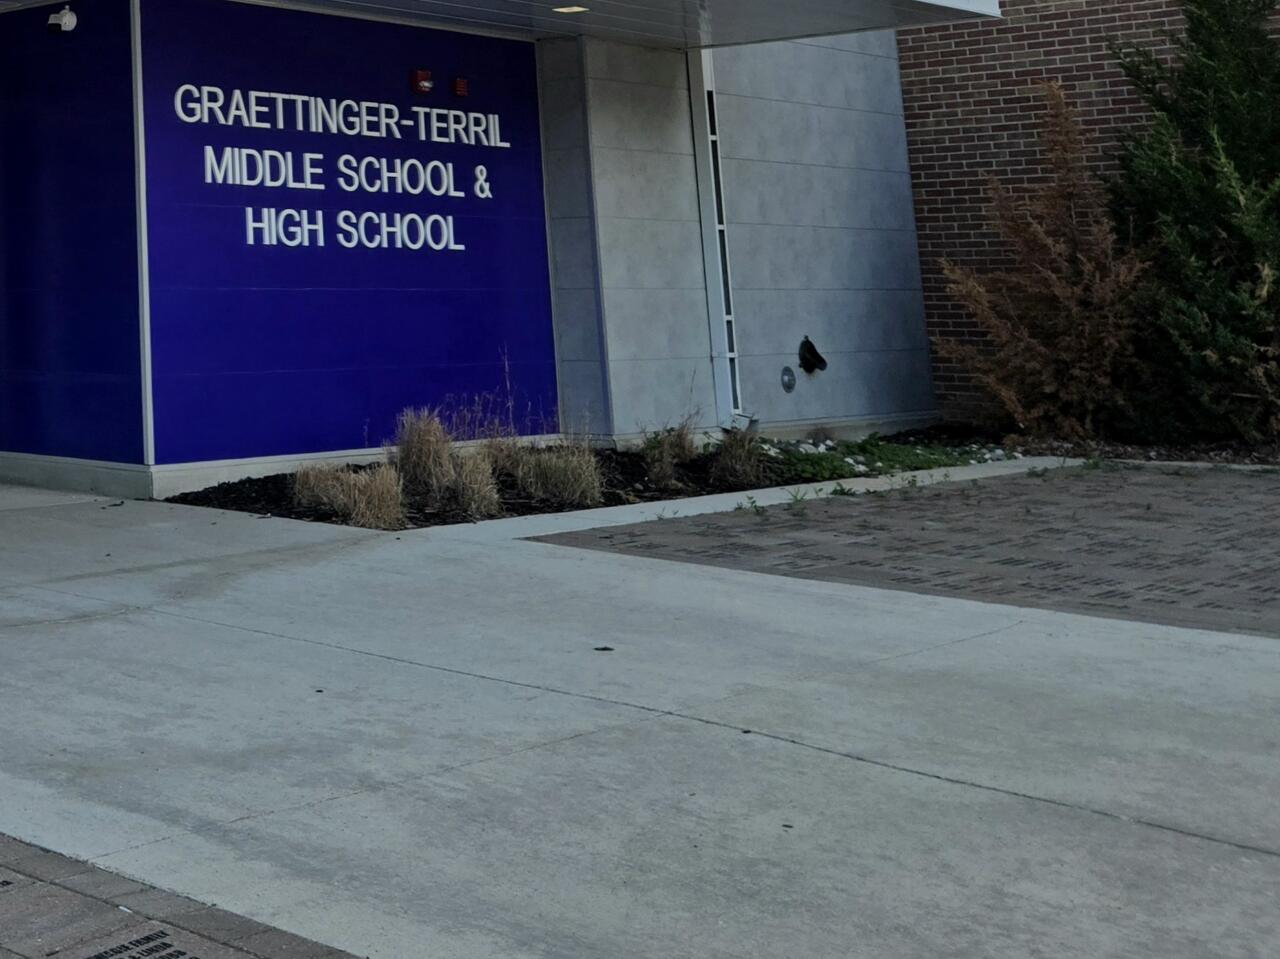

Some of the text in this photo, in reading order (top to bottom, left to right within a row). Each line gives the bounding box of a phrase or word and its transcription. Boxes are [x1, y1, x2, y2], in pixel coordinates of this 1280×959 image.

[174, 84, 511, 148] GRAETTINGER-TERRIL
[204, 145, 493, 199] MIDDLE SCHOOL &
[245, 207, 466, 251] HIGH SCHOOL
